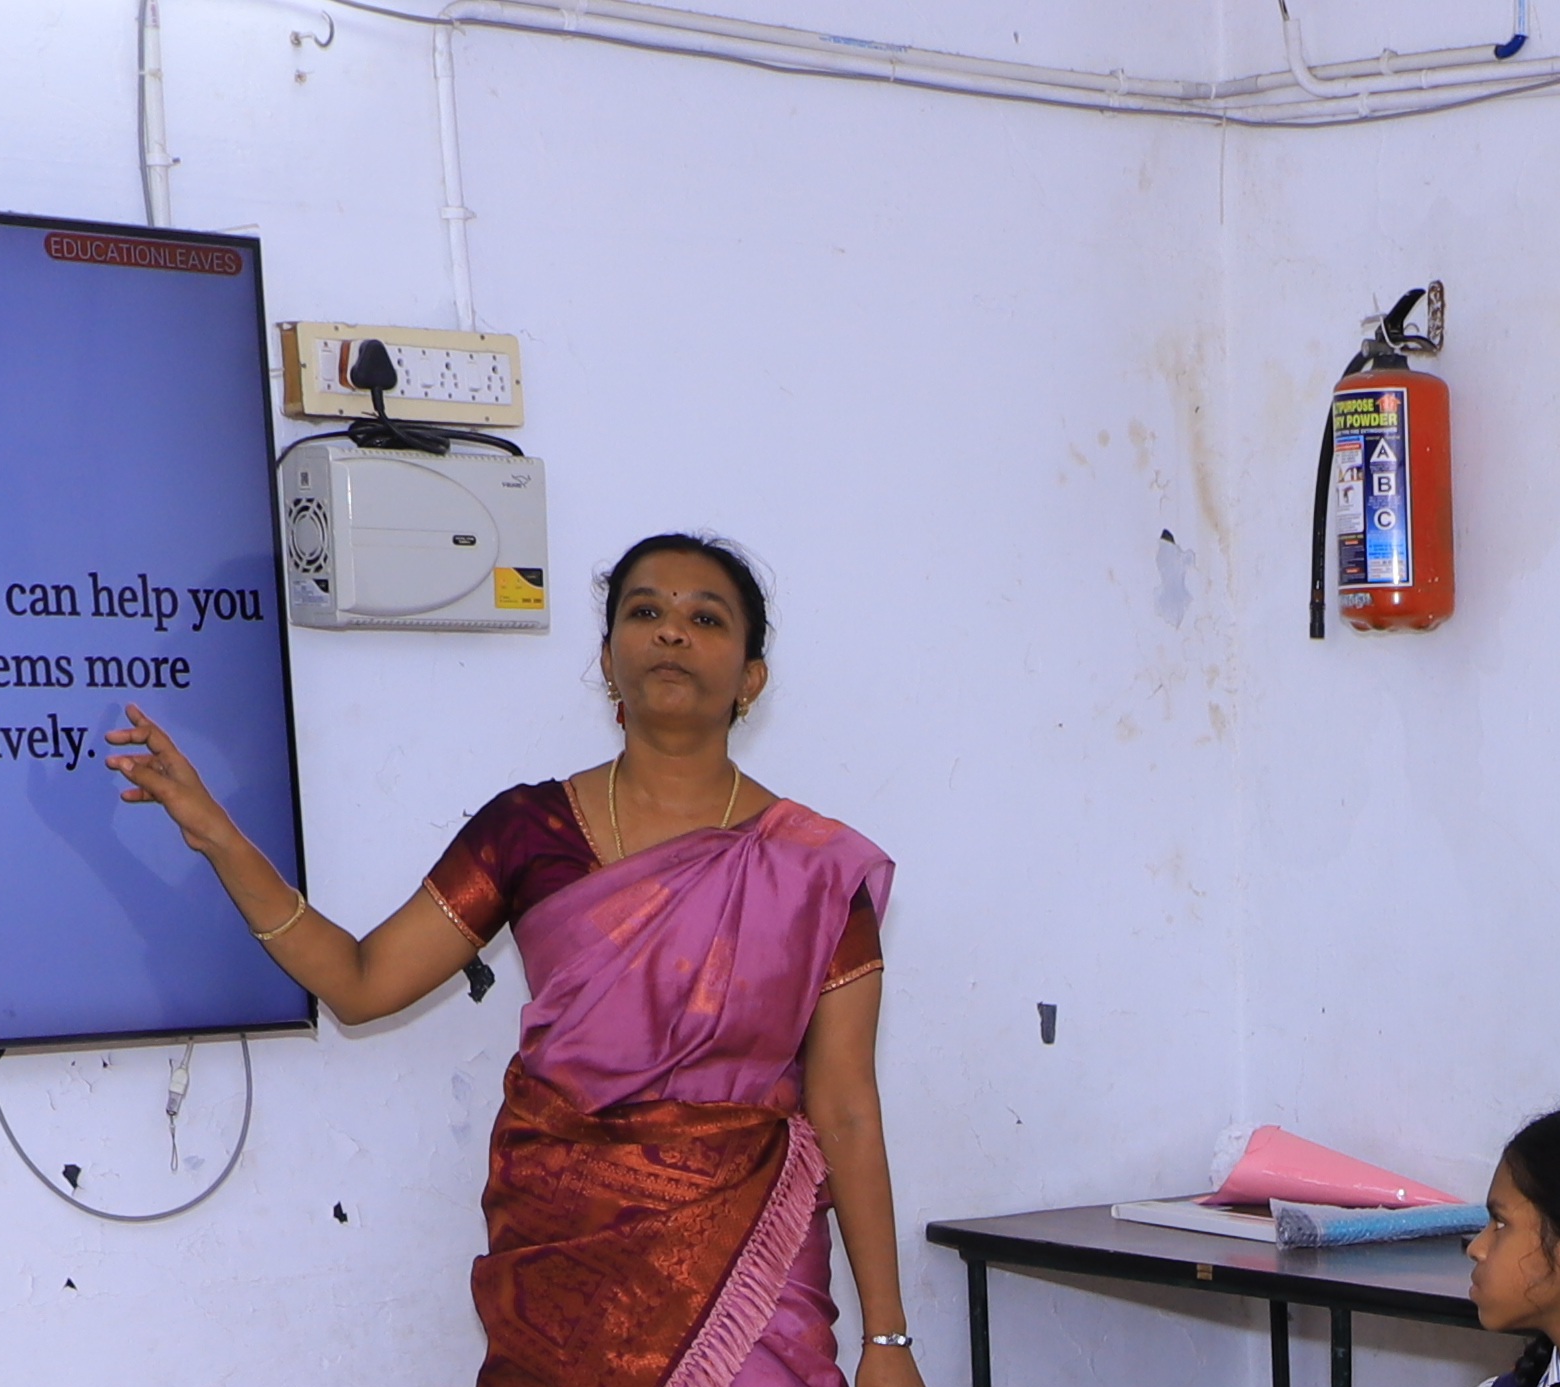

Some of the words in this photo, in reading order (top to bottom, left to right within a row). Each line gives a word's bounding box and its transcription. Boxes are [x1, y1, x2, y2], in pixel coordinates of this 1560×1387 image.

[50, 237, 236, 272] EDUCATIONLEAVES
[1347, 412, 1398, 428] POWDER
[1377, 444, 1390, 459] A
[1378, 476, 1392, 493] B
[1377, 511, 1392, 527] C
[5, 581, 81, 617] can
[88, 572, 178, 631] help
[187, 588, 264, 631] you
[84, 655, 190, 688] more
